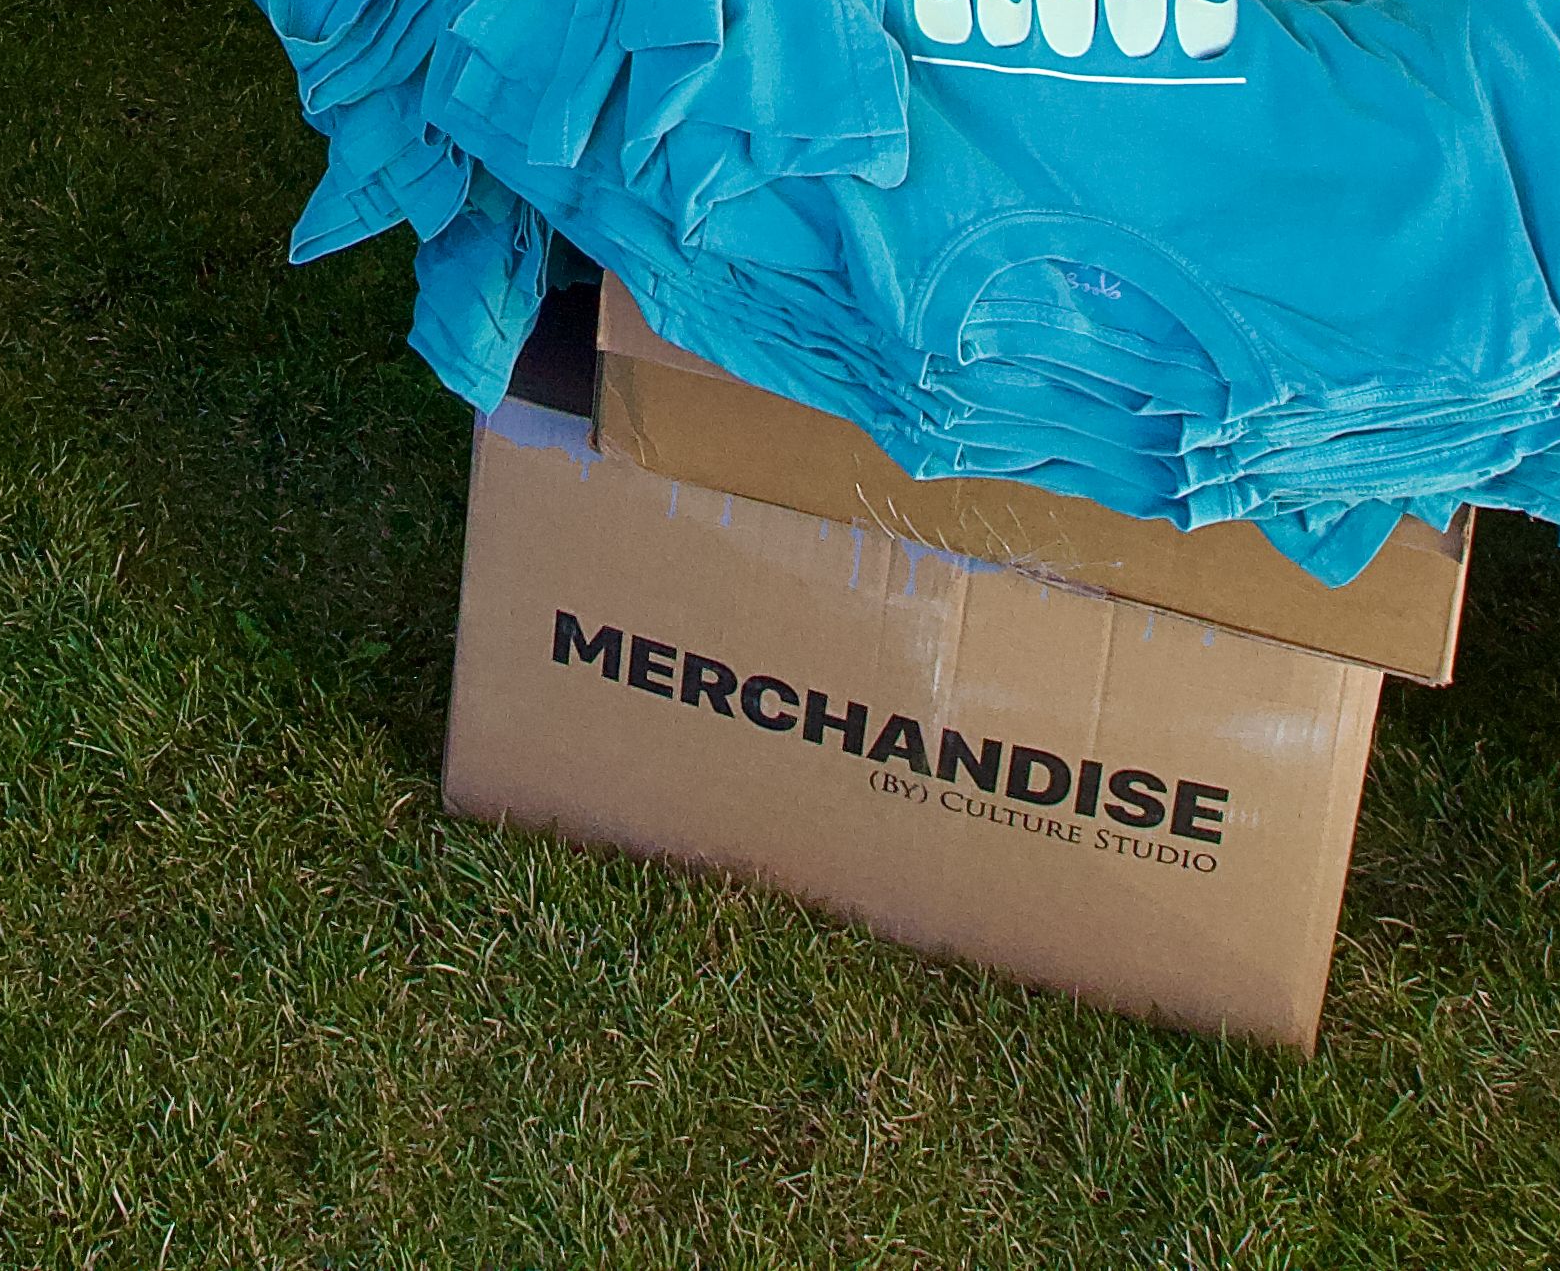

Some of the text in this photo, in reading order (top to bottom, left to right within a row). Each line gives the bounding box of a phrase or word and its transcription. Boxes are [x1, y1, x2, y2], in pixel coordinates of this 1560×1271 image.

[551, 608, 1232, 845] MERCHANDISE
[867, 769, 1218, 876] (BY) CULTURE STUDIO
